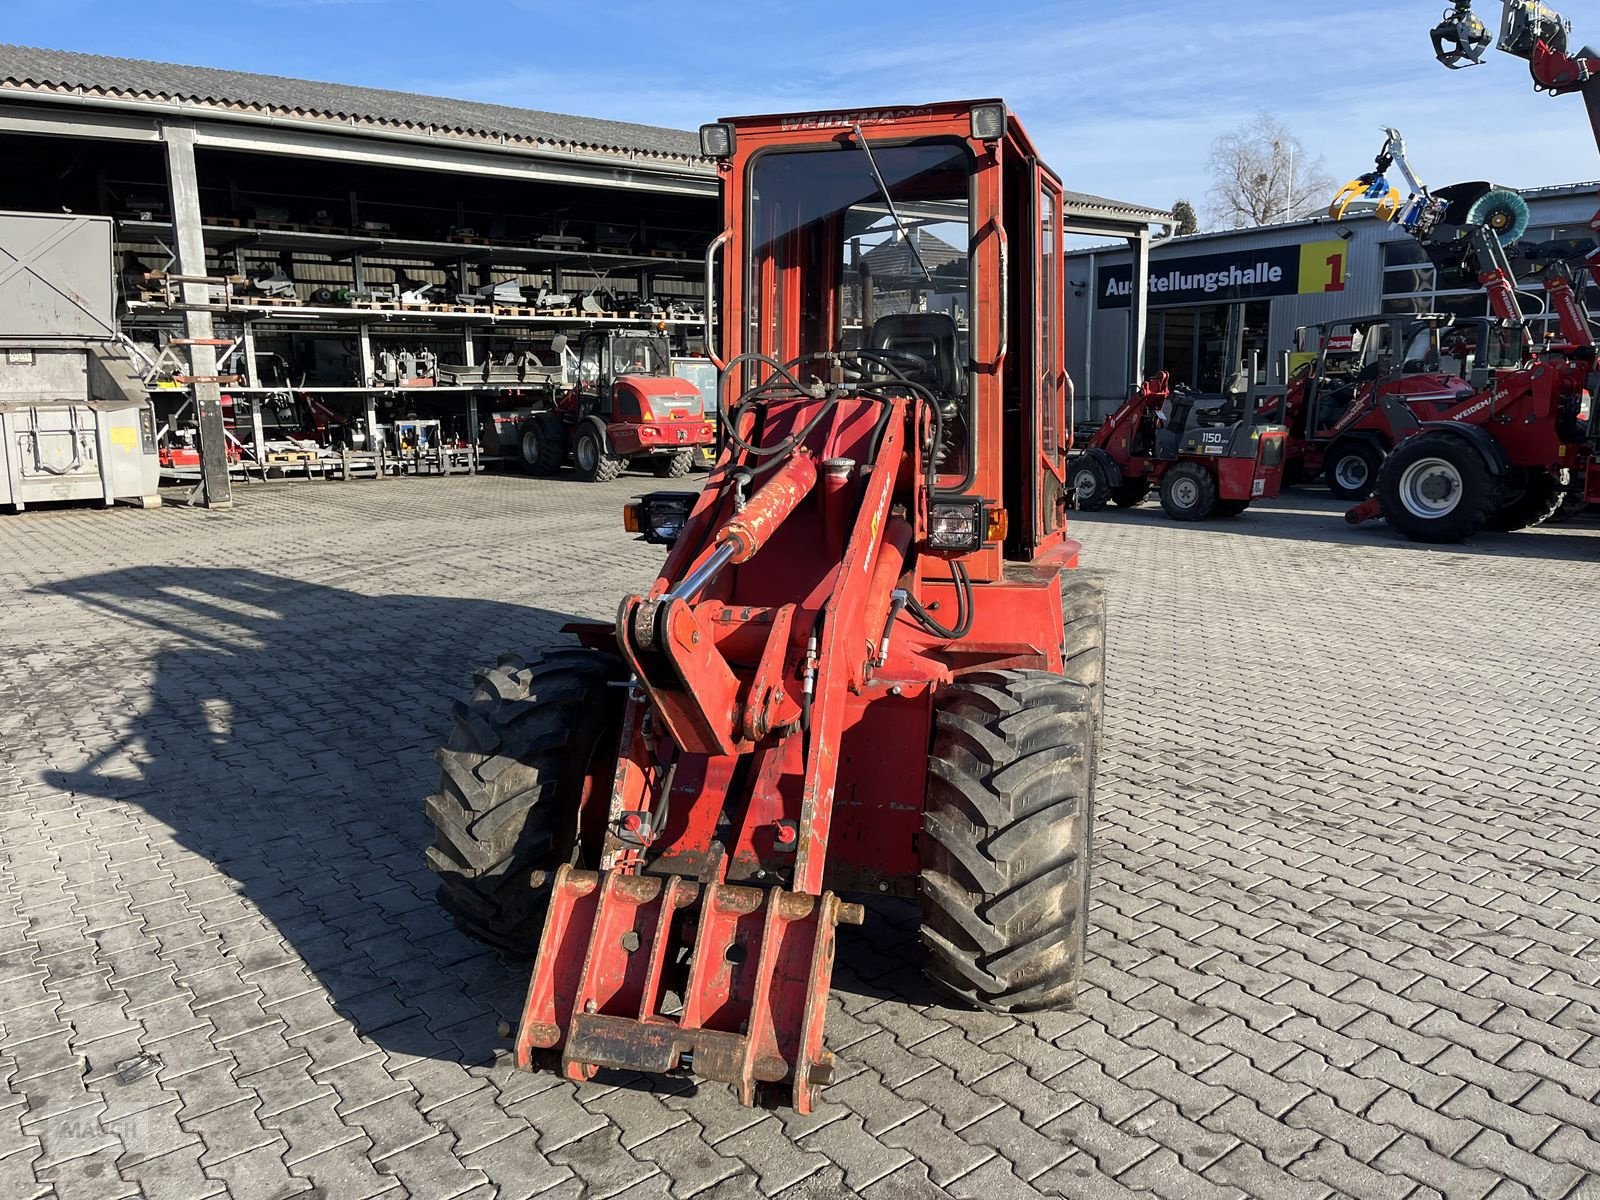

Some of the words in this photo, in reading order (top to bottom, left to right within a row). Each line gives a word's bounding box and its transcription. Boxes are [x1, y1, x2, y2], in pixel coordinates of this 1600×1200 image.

[1105, 262, 1282, 296] Autellungshalle
[1324, 254, 1345, 292] 1
[1202, 432, 1222, 443] 1150
